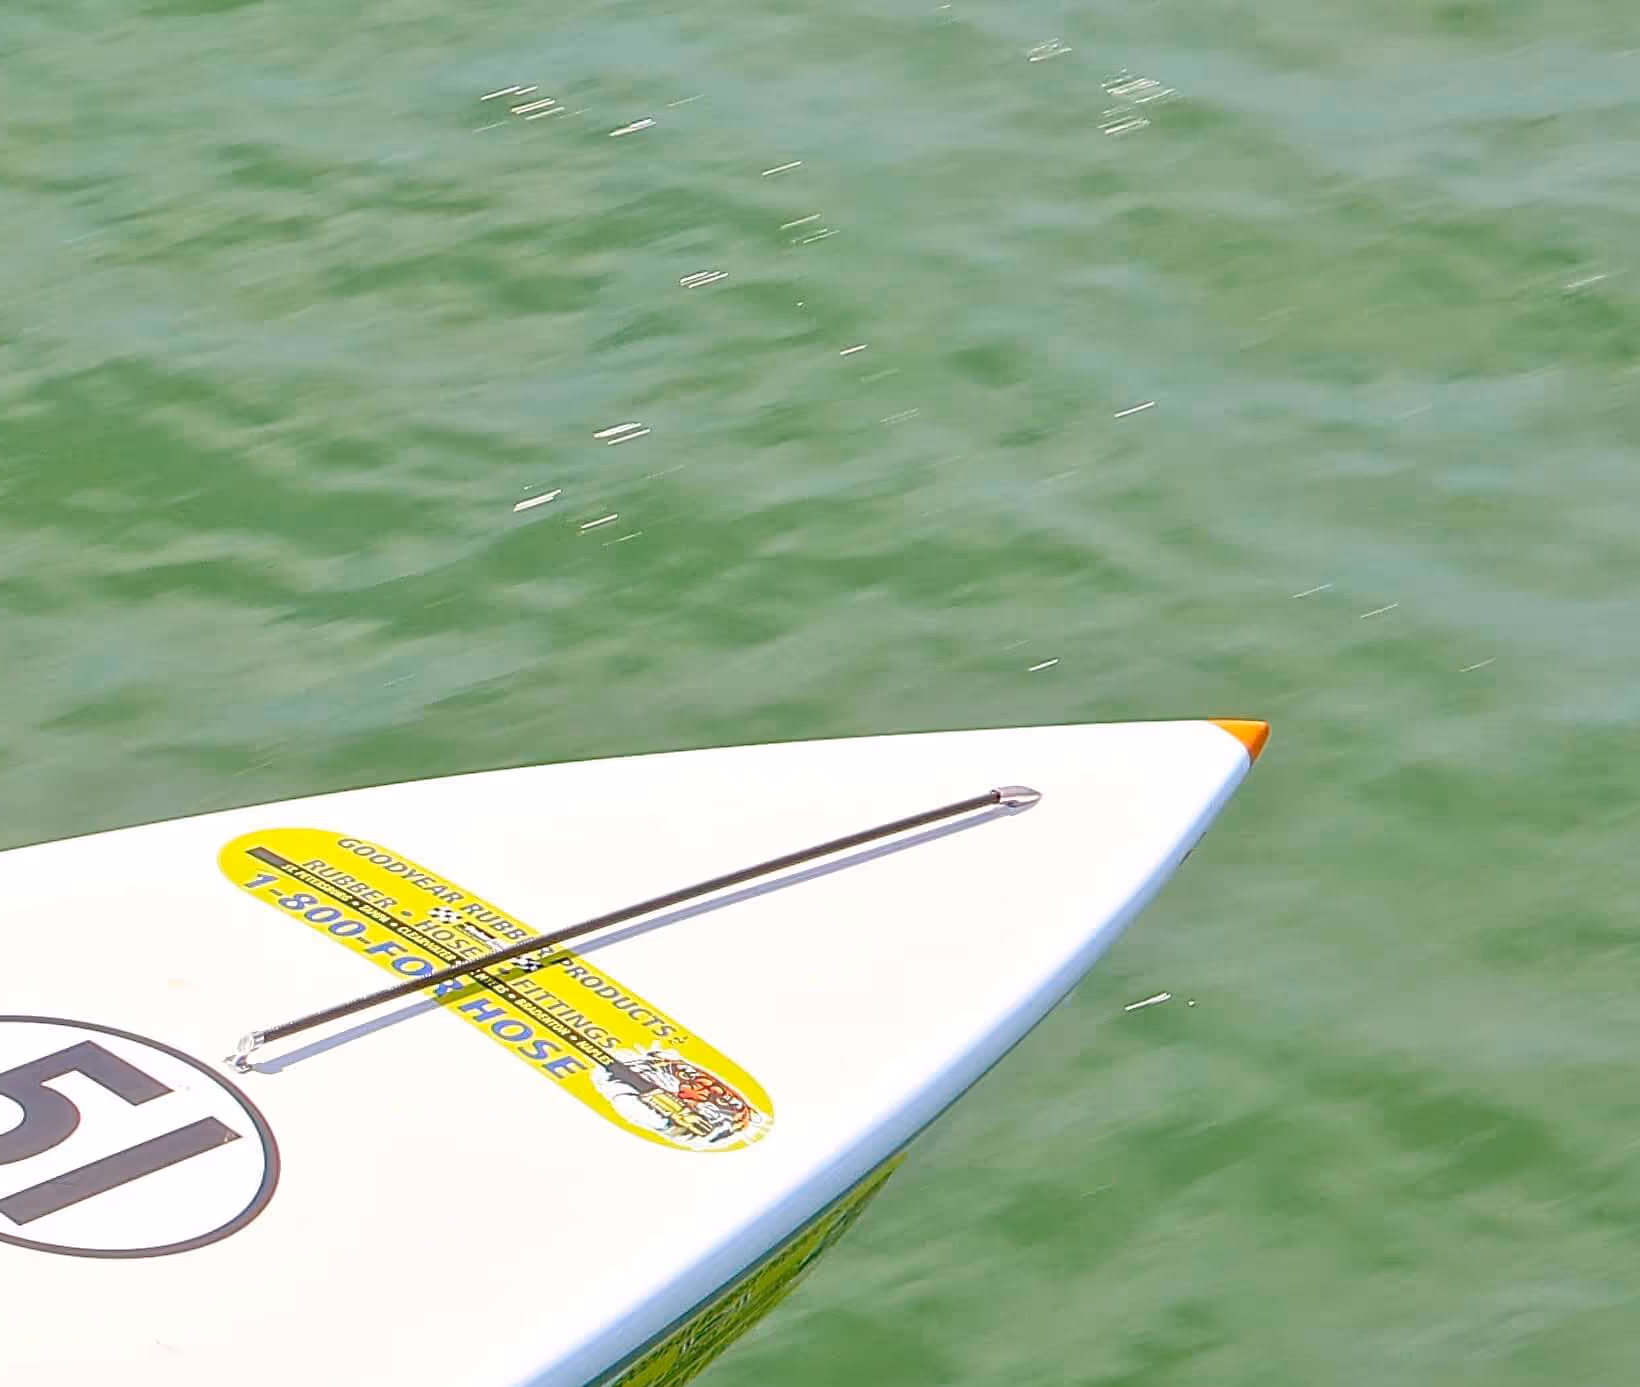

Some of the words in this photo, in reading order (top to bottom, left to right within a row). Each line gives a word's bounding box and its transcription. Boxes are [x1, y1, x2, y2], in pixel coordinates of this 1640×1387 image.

[301, 859, 398, 909] RUBBER
[511, 977, 622, 1051] FITTINGS
[337, 838, 465, 904] GOODYEAR
[459, 902, 555, 957] RUBBR
[549, 955, 677, 1038] PRODUCTS
[457, 997, 589, 1080] HOSE
